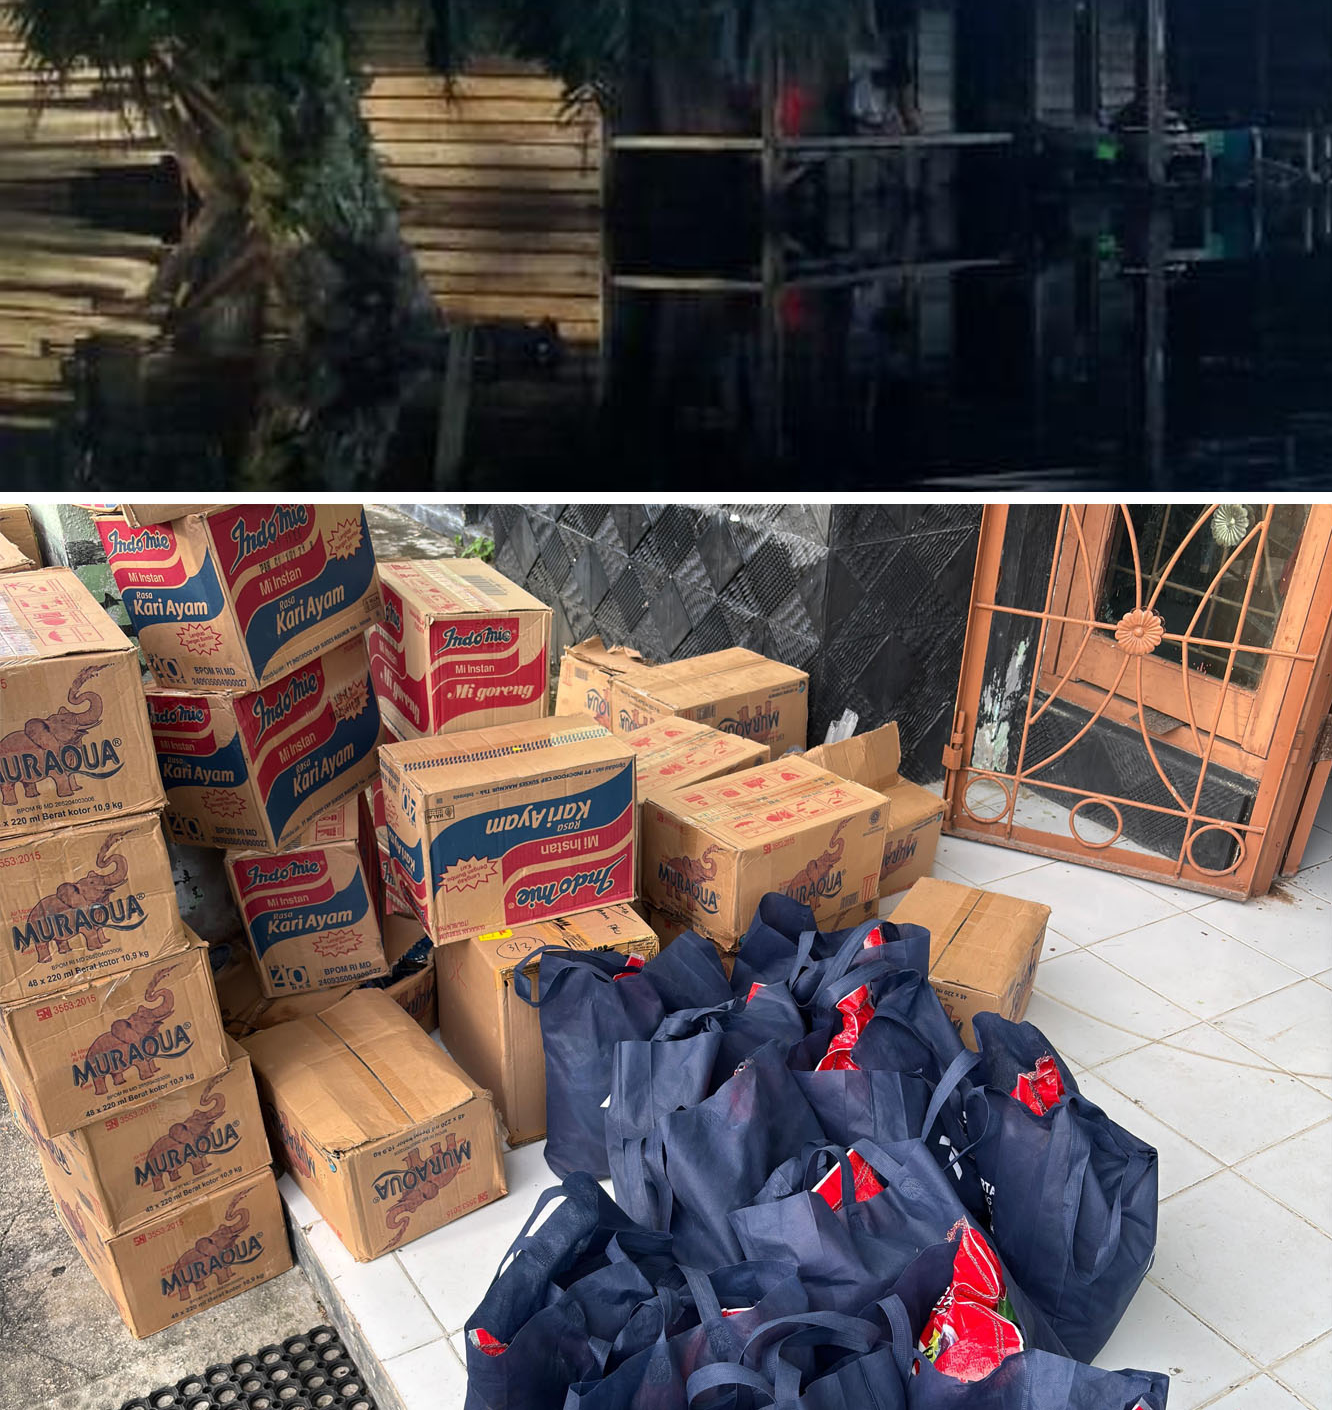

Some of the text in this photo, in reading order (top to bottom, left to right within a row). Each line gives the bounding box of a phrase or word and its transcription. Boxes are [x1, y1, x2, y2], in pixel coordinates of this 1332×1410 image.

[128, 572, 165, 583] Mi Instan
[259, 567, 303, 596] Mi Instan
[136, 591, 153, 600] Rasa
[279, 595, 296, 611] Rasa
[133, 599, 208, 620] Kari Ayam
[276, 599, 305, 636] Kari
[306, 584, 345, 621] Ayam
[193, 666, 236, 676] BPOM MD
[455, 663, 495, 674] Mi Instan
[447, 683, 535, 702] Mi goreng
[171, 741, 196, 751] Instan
[279, 731, 317, 765] Mi Instan
[162, 762, 235, 786] Kari Ayam
[293, 742, 356, 798] Kari Ayam
[11, 816, 27, 826] 220
[29, 814, 41, 823] ml
[42, 809, 66, 821] Berat
[68, 806, 91, 817] kotor
[93, 803, 110, 813] 10,9
[112, 801, 123, 811] kg
[16, 803, 54, 815] BPOM MD
[485, 798, 593, 835] Kari Ayam
[556, 818, 581, 832] Rasa
[540, 834, 600, 856] Mi Instan
[267, 894, 310, 908] Mi Instan
[268, 909, 353, 935] Kari Ayam
[273, 911, 293, 920] Rasa
[28, 979, 39, 988] 48
[47, 973, 62, 984] 220
[64, 968, 74, 979] ml
[75, 962, 98, 976] Berat
[98, 957, 120, 969] kotor
[121, 952, 137, 963] 10,9
[138, 949, 150, 959] kg
[324, 961, 372, 976] BPOM RI MD
[53, 994, 97, 1016] 3553:2015
[85, 1072, 195, 1118] 48 220 ml Berat kotor 10,9 kg
[160, 1197, 173, 1208] 220
[183, 1184, 201, 1197] Berat
[201, 1175, 219, 1188] kotor
[234, 1165, 243, 1175] kg
